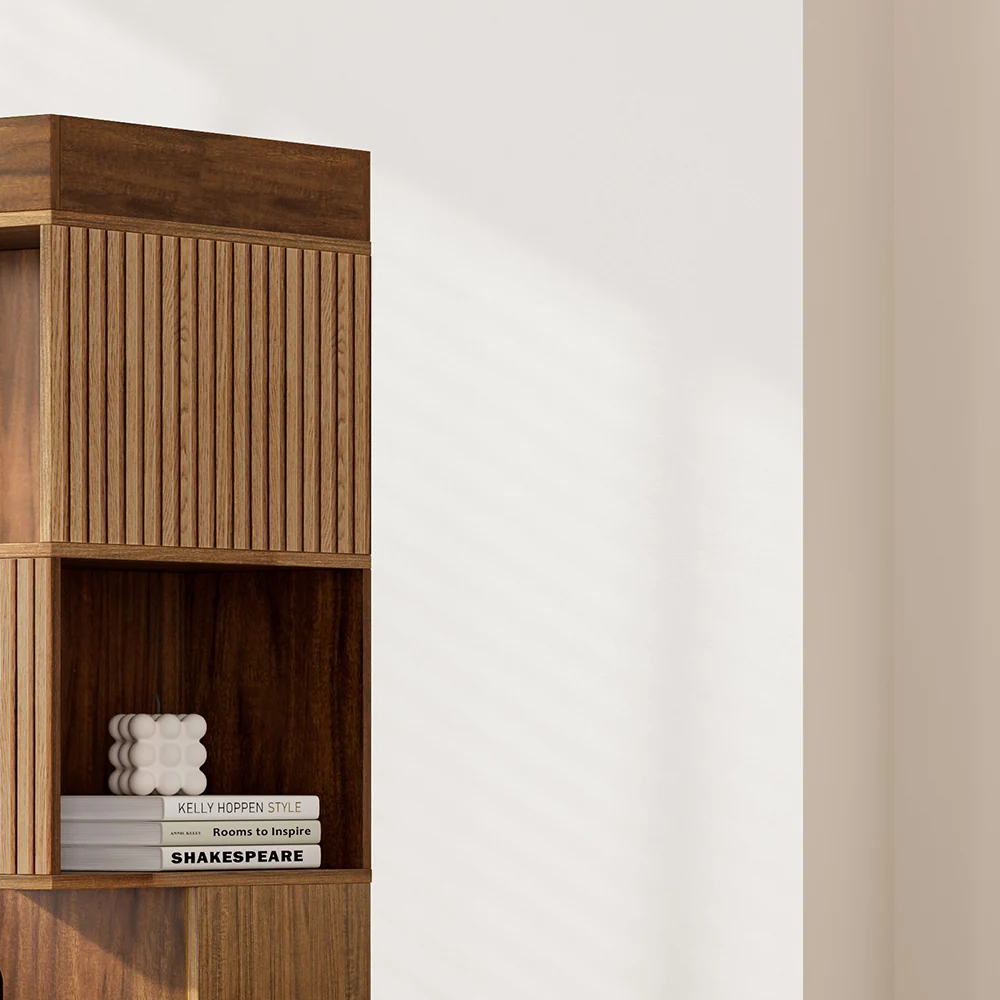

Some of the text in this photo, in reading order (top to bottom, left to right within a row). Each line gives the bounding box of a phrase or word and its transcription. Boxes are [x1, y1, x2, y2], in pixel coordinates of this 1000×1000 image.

[178, 801, 302, 814] KELLY HOPPEN STYLE
[213, 826, 312, 838] Rooms to Inspire
[171, 849, 304, 864] SHAKESPEARE
